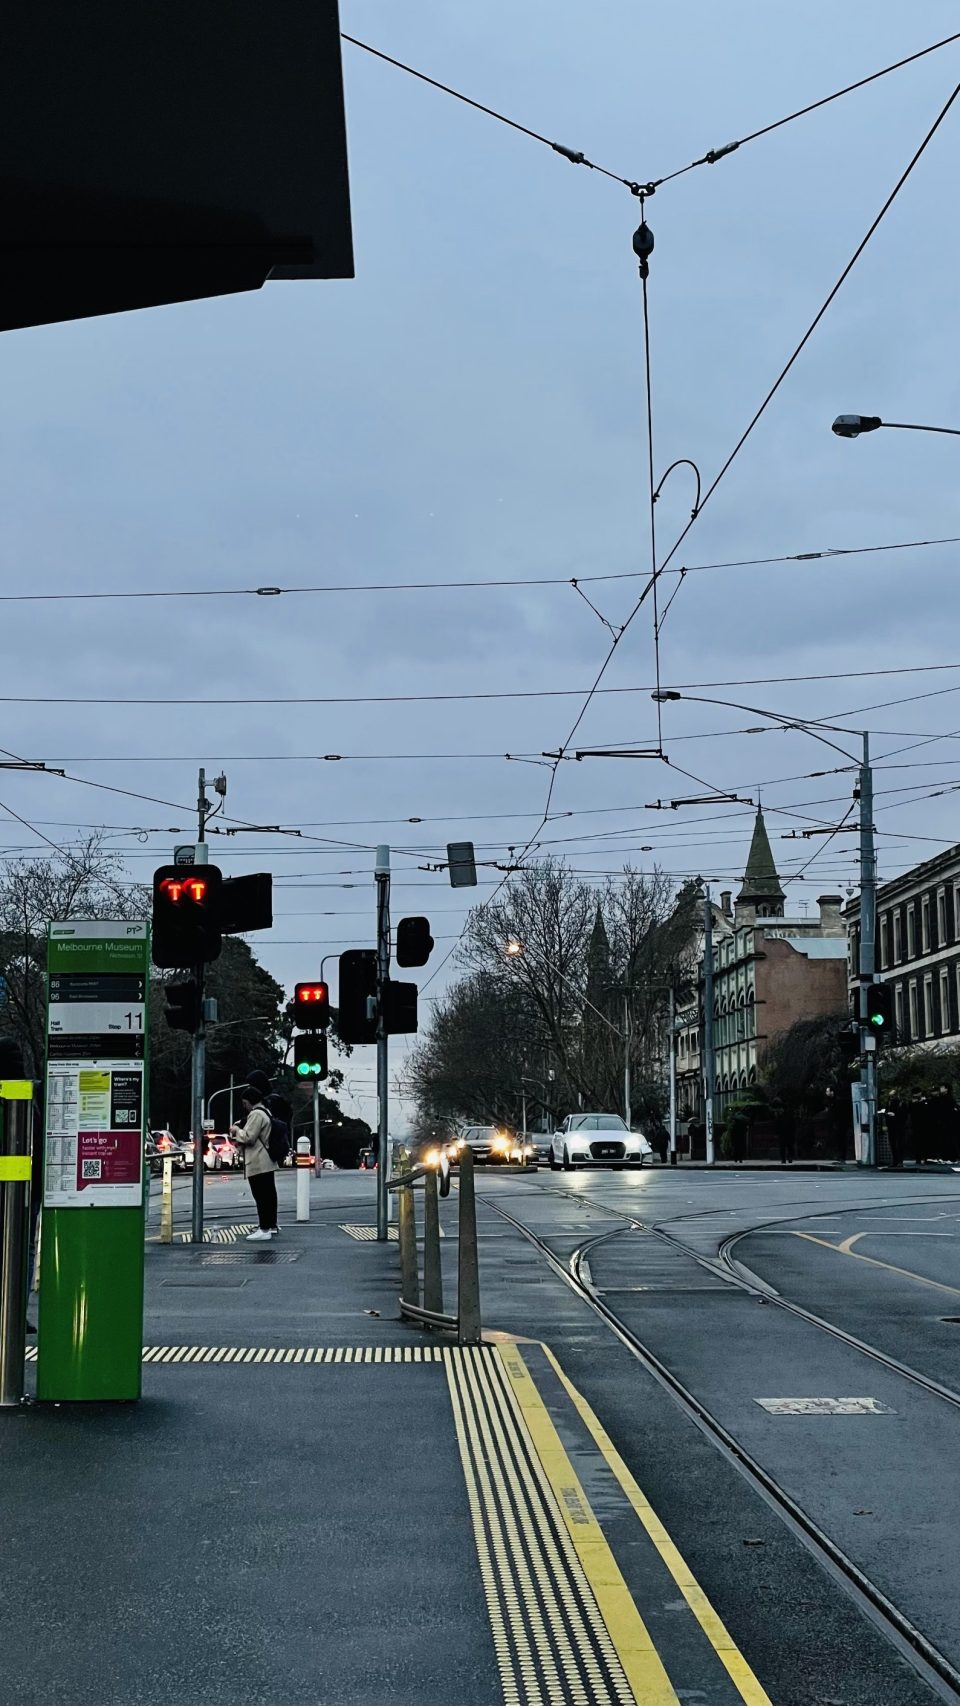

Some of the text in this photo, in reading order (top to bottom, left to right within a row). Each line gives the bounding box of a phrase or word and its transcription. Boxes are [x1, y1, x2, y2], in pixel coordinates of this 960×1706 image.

[57, 942, 142, 951] Melbourne Museum
[124, 1012, 142, 1029] 11
